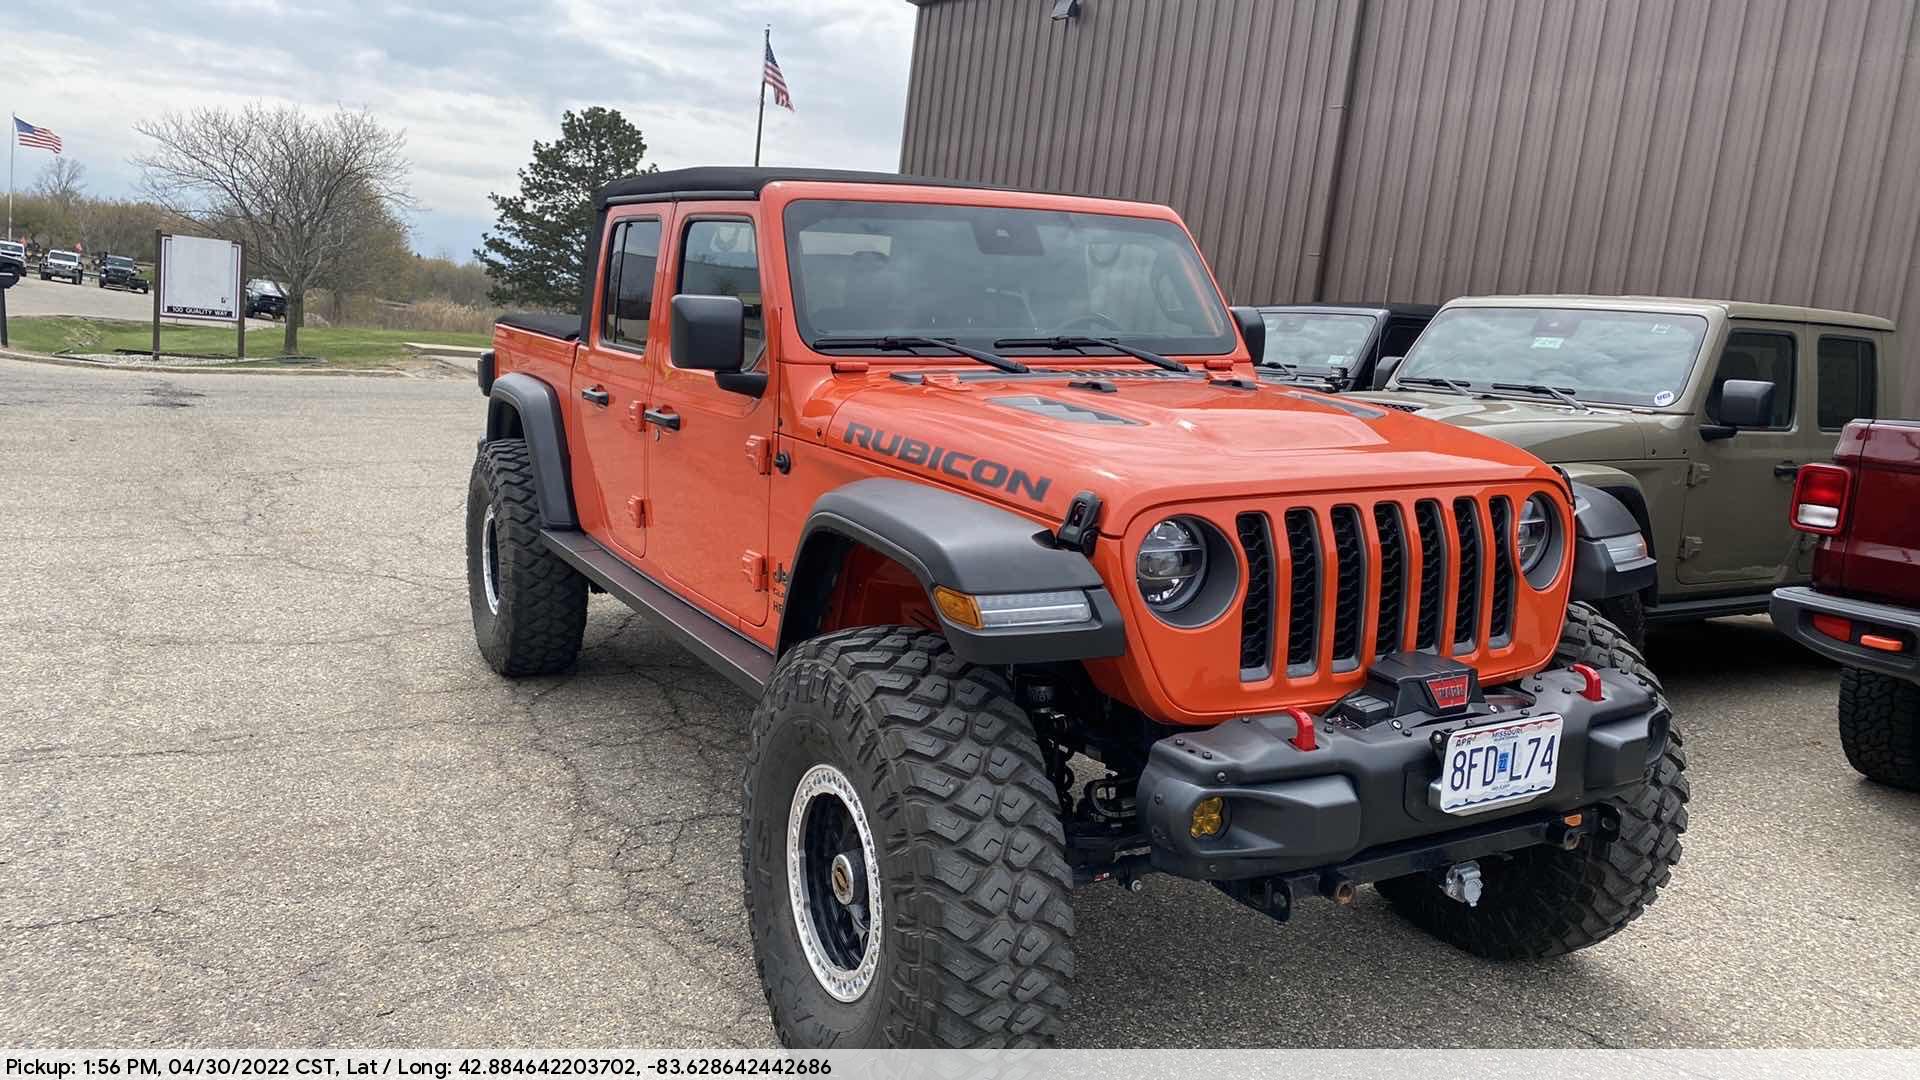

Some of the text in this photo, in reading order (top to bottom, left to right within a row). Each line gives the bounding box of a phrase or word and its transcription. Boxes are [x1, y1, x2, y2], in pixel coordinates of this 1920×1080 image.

[186, 307, 212, 315] QUALITY
[843, 422, 1052, 502] RUBICON
[1492, 728, 1522, 737] MISSOURI
[1456, 737, 1472, 747] APR
[1450, 734, 1556, 791] 8FD L74
